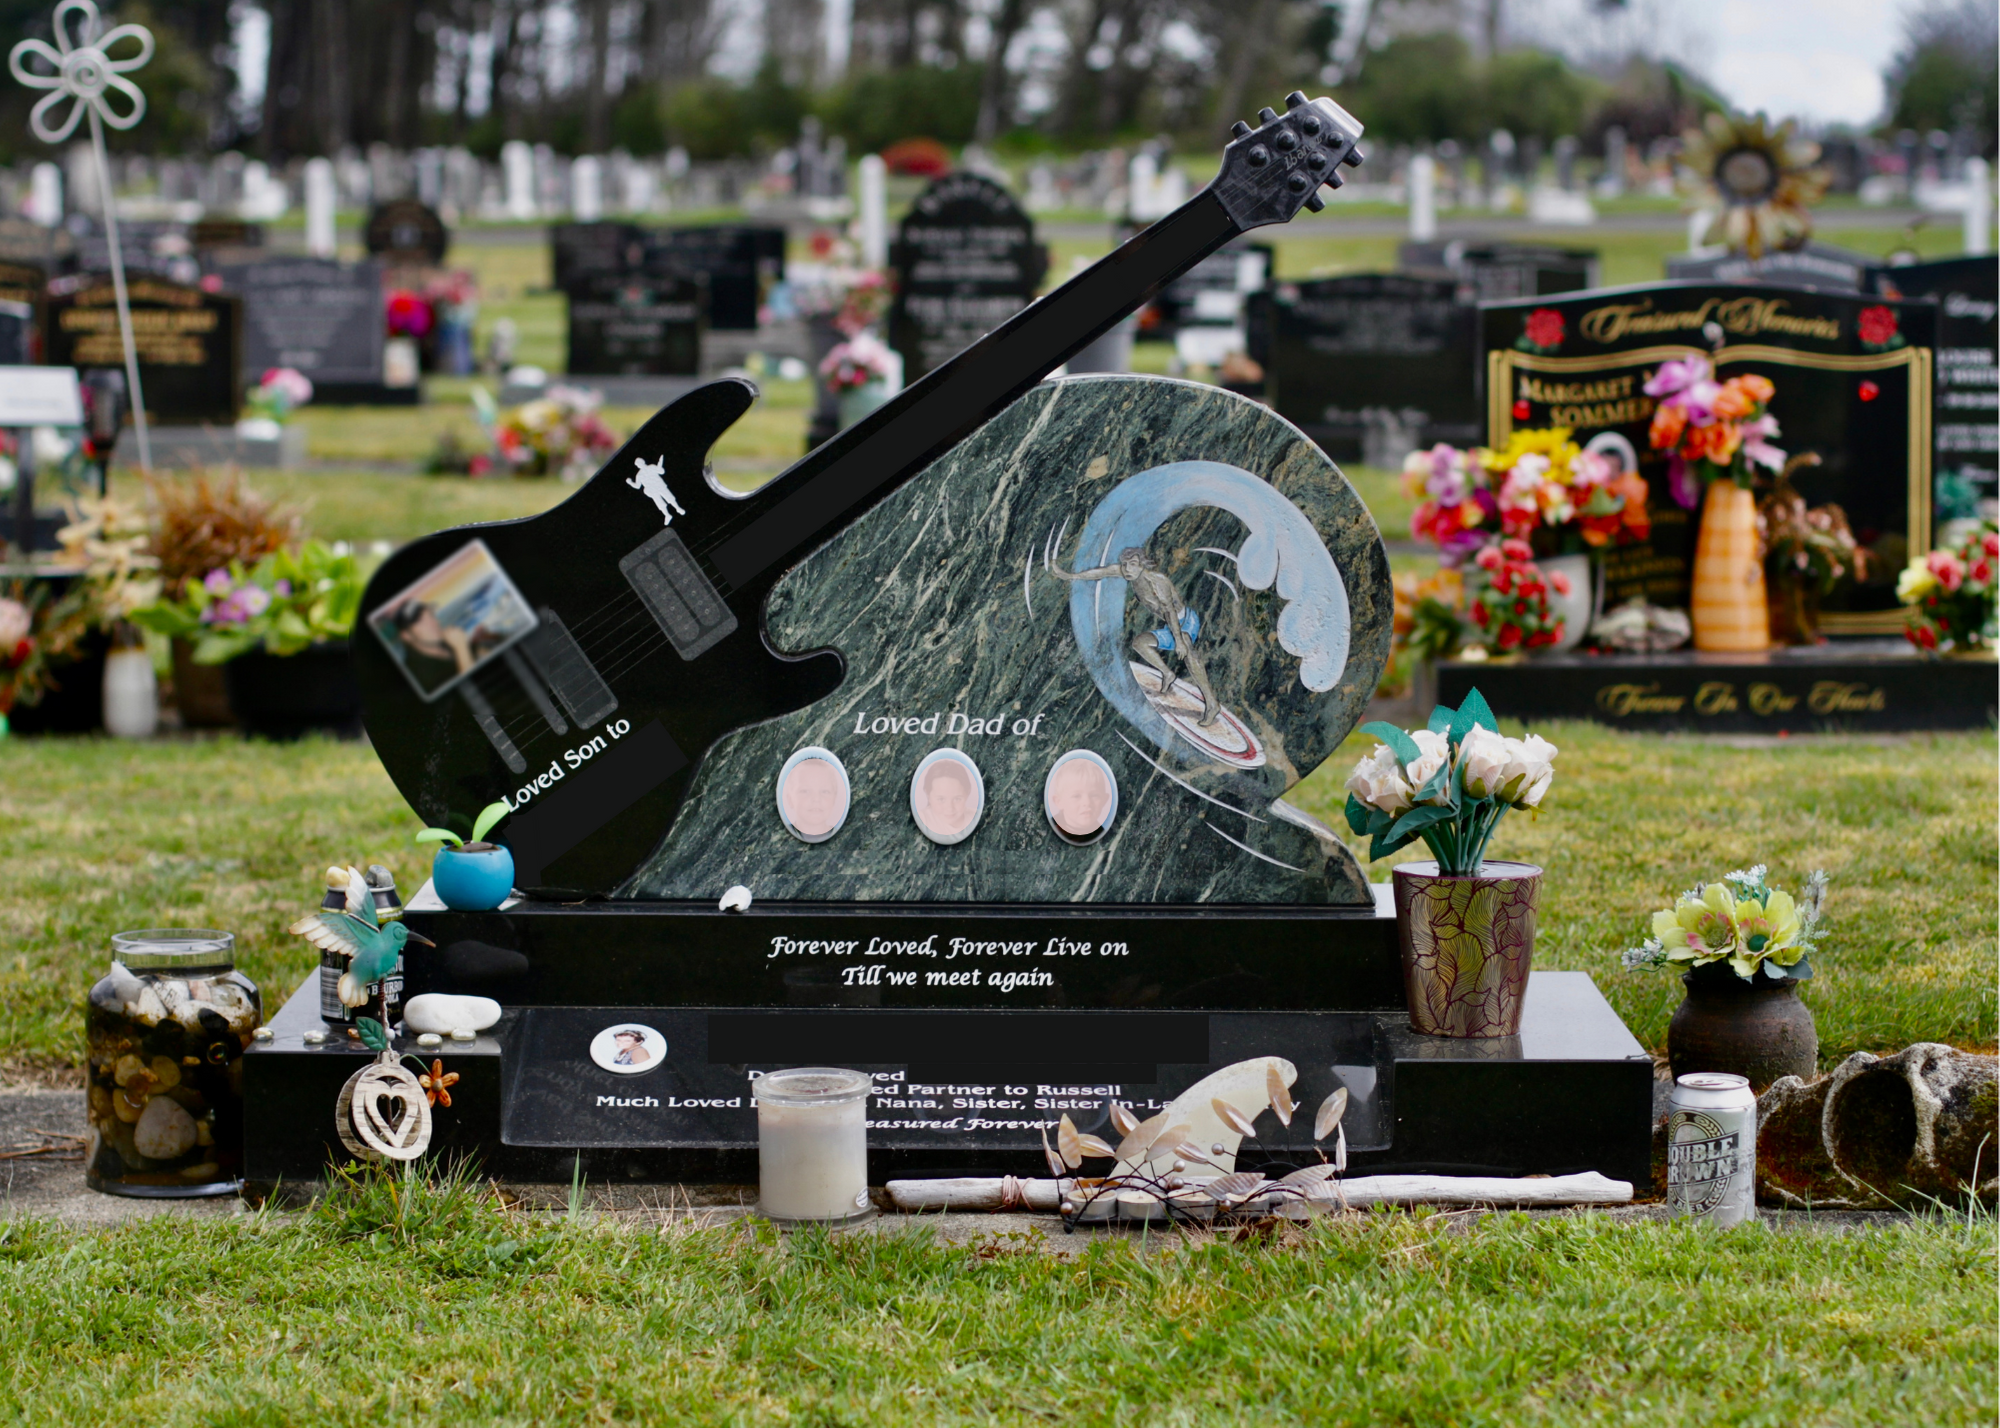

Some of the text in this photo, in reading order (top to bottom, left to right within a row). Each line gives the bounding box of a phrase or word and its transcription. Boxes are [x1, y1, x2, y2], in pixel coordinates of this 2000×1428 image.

[1520, 373, 1635, 403] MARGARET
[1694, 681, 1738, 716] In
[1748, 681, 1799, 716] Our
[853, 711, 1046, 736] Loved Dad of
[500, 719, 631, 812] Loved Son to
[767, 934, 1131, 960] Forever Loved, Forever Live on
[371, 980, 404, 995] BURBO
[841, 964, 1055, 993] Till we meet again
[907, 1083, 997, 1096] Partner
[1003, 1084, 1029, 1096] to
[1036, 1084, 1122, 1096] Russell
[595, 1095, 660, 1108] Much
[667, 1096, 742, 1108] Loved
[876, 1097, 944, 1110] Nana,
[952, 1097, 1027, 1111] Sister,
[1034, 1097, 1103, 1110] Sister
[1110, 1098, 1174, 1110] In-La
[865, 1116, 1061, 1132] easured Forever
